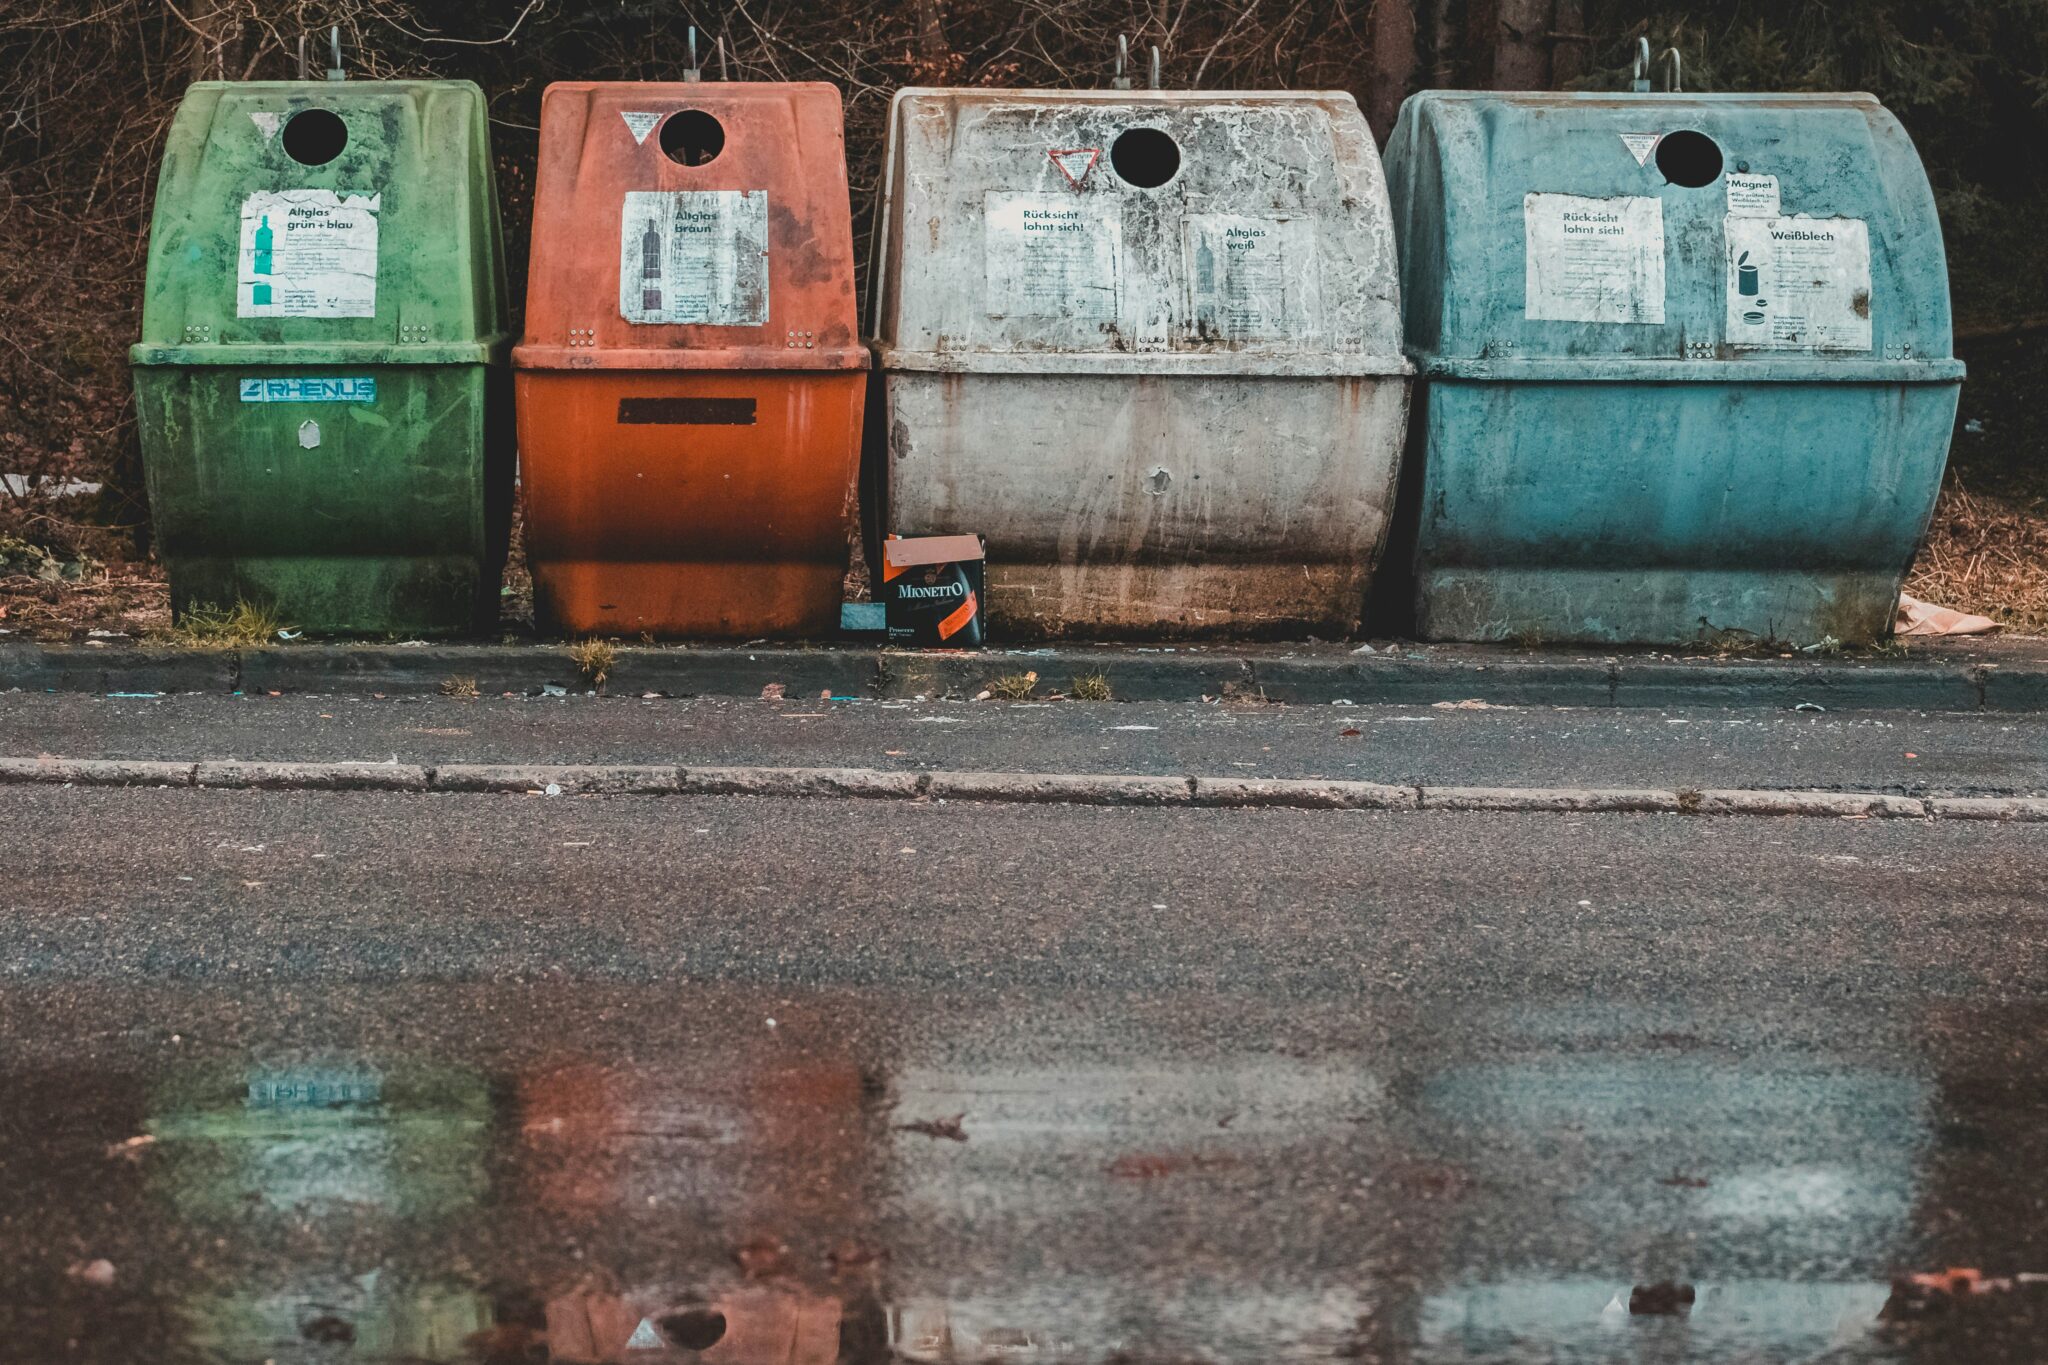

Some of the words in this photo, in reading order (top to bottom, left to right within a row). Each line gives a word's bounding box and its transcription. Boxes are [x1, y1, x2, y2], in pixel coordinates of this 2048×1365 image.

[1731, 180, 1772, 190] Magnet
[288, 207, 330, 218] Altglas
[675, 210, 718, 222] Altglas
[1023, 210, 1078, 220] Rücksicht
[1563, 212, 1618, 222] Rücksicht
[287, 219, 316, 231] grün
[327, 219, 353, 230] blau
[674, 223, 712, 233] braun
[1023, 222, 1054, 231] lohnt
[1058, 223, 1084, 232] sich!
[1563, 224, 1594, 234] lohnt
[1598, 225, 1625, 235] sich!
[1226, 227, 1266, 239] Altglas
[1771, 231, 1834, 242] Weißblech
[1226, 240, 1255, 250] weiß
[267, 382, 375, 397] RHENUS
